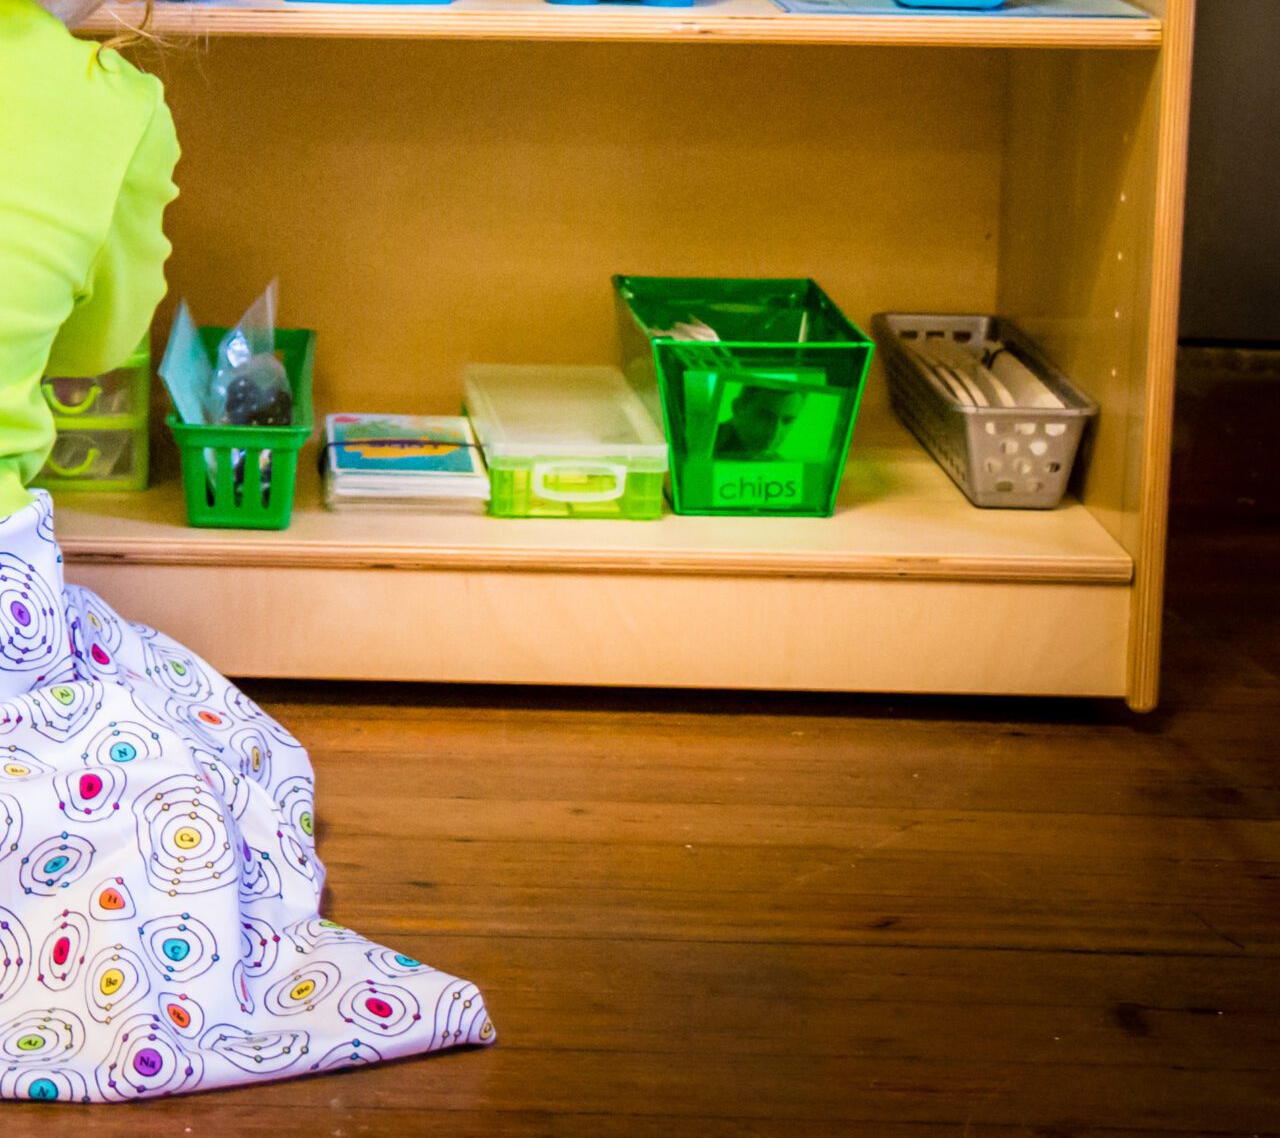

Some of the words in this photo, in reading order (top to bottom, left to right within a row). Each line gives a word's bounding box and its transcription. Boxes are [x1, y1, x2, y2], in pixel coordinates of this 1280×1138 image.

[719, 476, 797, 503] chips
[117, 747, 129, 759] N
[179, 832, 195, 843] Ca
[170, 944, 182, 956] C
[105, 976, 119, 988] Be
[138, 1055, 157, 1070] Na
